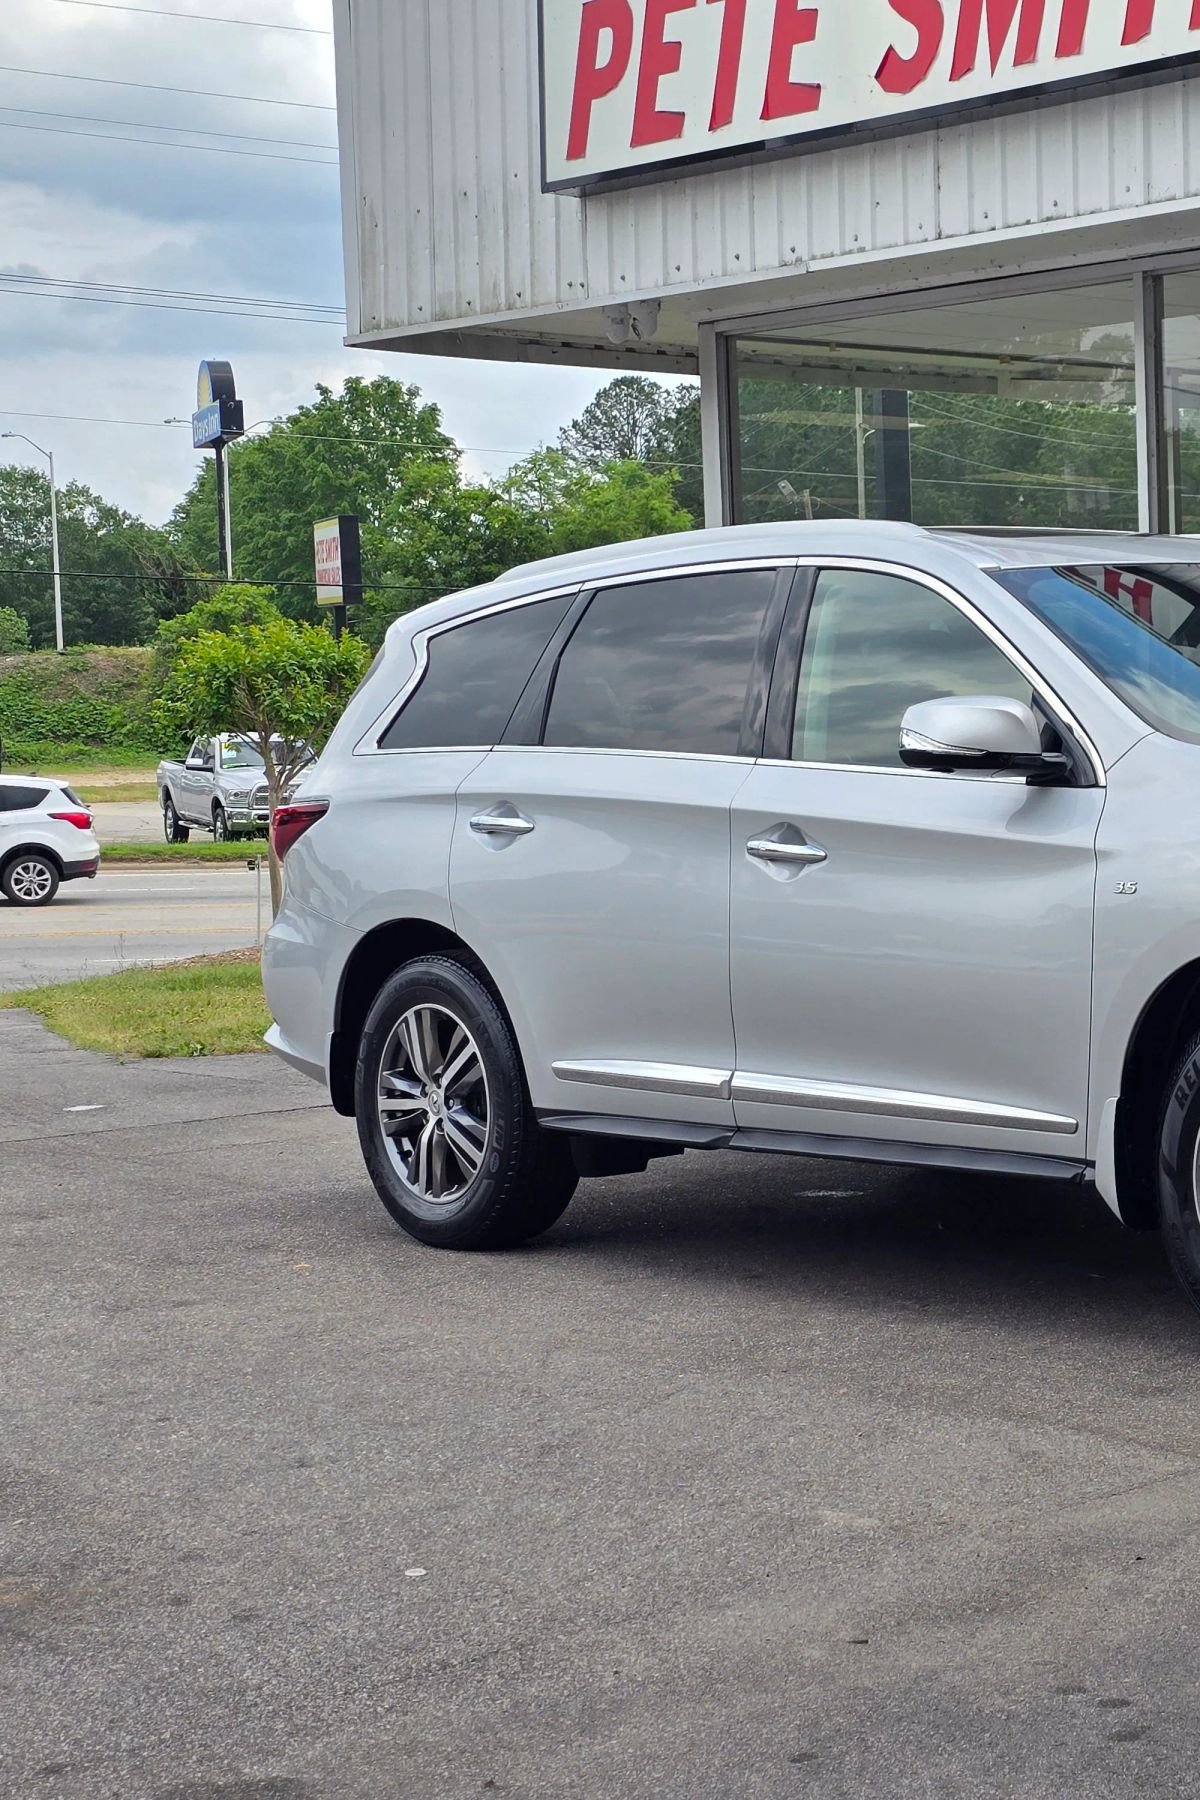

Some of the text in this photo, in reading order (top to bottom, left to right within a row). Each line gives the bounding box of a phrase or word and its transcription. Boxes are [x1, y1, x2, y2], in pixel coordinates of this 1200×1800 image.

[566, 0, 822, 161] PETE
[208, 412, 218, 435] Inn
[1113, 881, 1138, 895] 3.5
